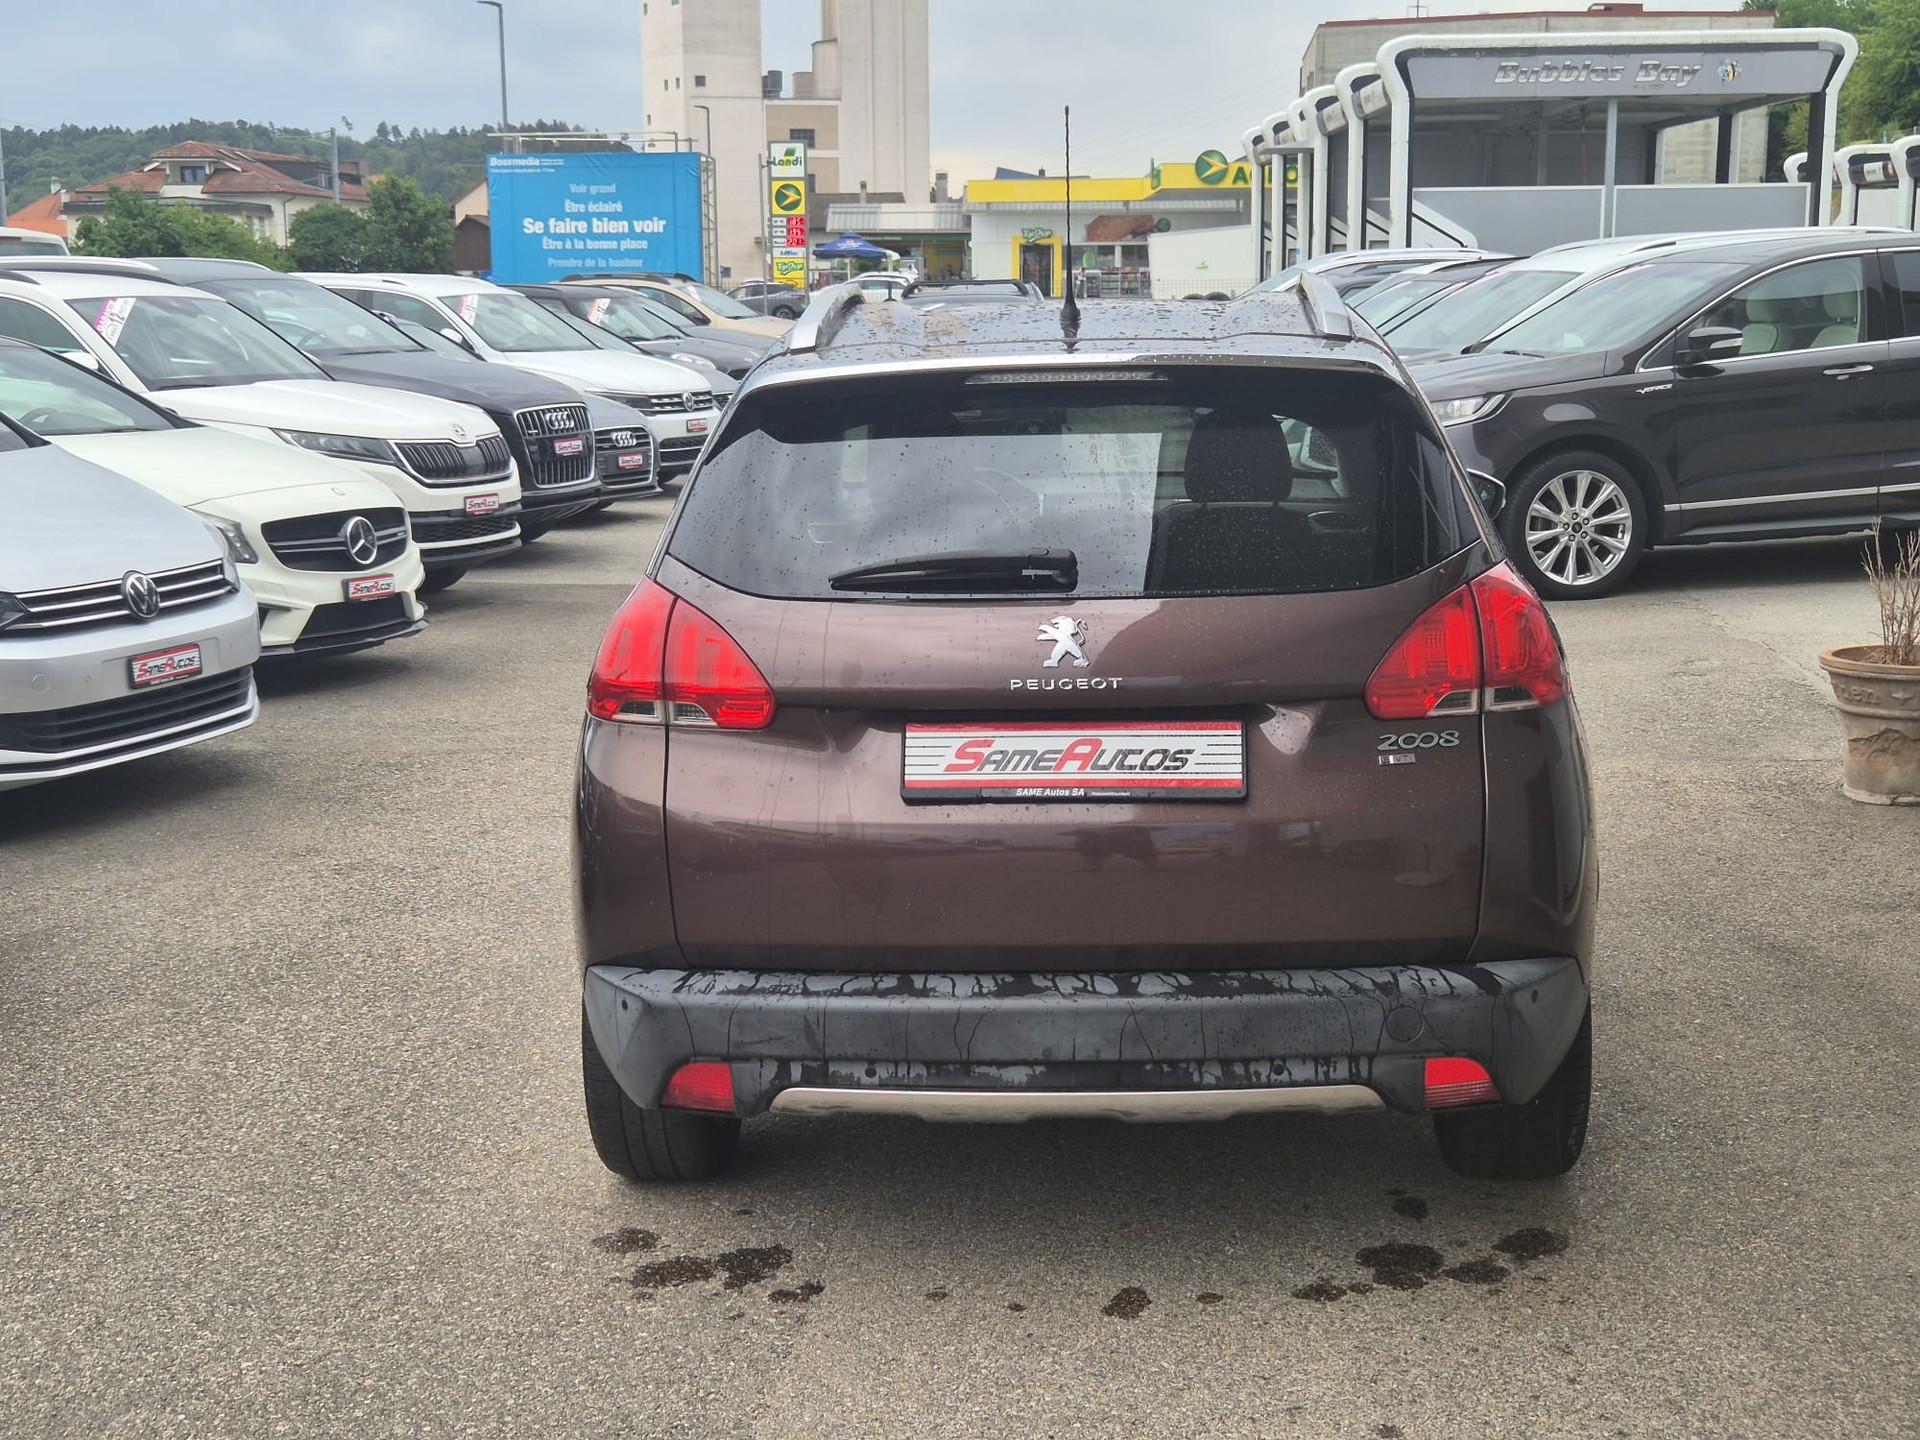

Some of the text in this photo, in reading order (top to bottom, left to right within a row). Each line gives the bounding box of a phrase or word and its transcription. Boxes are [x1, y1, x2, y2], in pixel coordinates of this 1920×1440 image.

[1494, 60, 1702, 87] Bubbles Bay
[490, 156, 540, 166] Bossmedia
[772, 156, 802, 166] Landi
[569, 184, 616, 195] Voir grand
[565, 199, 623, 212] Être éclairé
[523, 217, 666, 234] Se faire bien voir
[542, 236, 648, 251] Être à la bonne place
[548, 258, 643, 267] Prendre de la hauteur
[1010, 677, 1123, 691] PEUGEOT
[1377, 730, 1460, 751] 2008
[1016, 788, 1042, 796] SAME
[1044, 788, 1070, 796] Autos
[1071, 788, 1085, 796] SA
